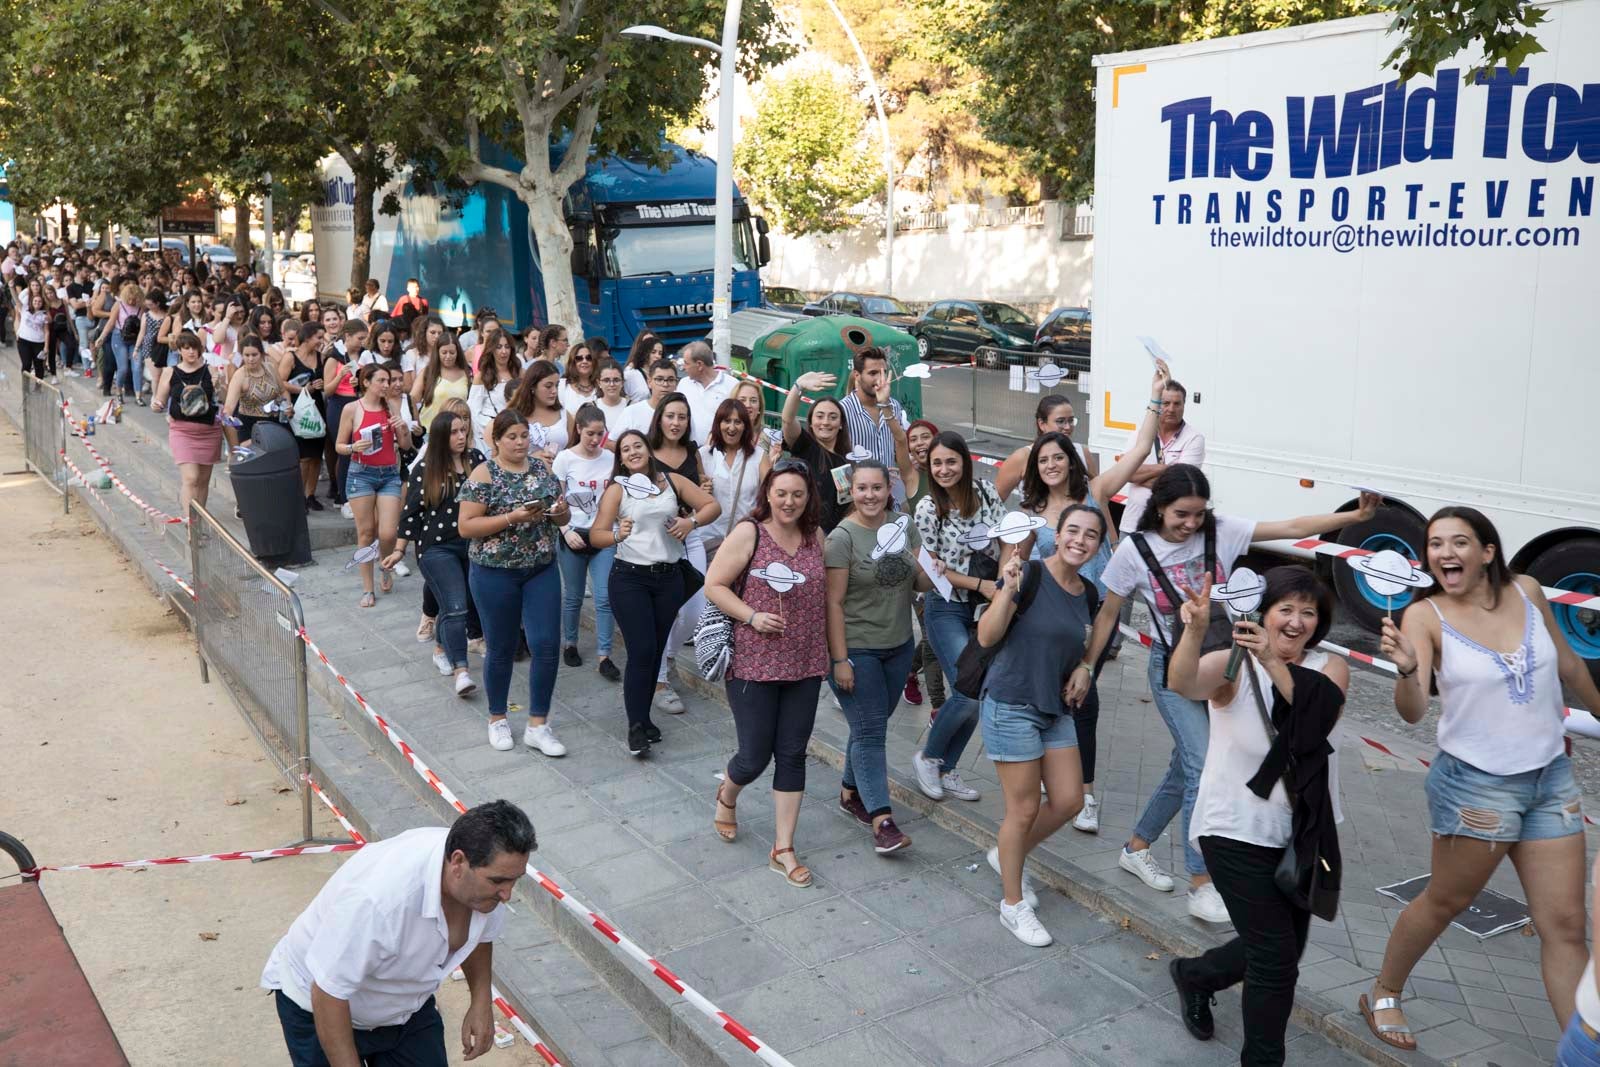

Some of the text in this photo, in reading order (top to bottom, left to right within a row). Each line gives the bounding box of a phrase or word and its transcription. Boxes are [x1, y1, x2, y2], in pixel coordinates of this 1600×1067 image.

[1161, 96, 1274, 182] The
[1286, 67, 1460, 179] Wild
[635, 205, 661, 218] The
[661, 203, 690, 217] Wild
[1209, 222, 1580, 253] thewildtour@thewildtour.com
[669, 303, 714, 315] IVECO
